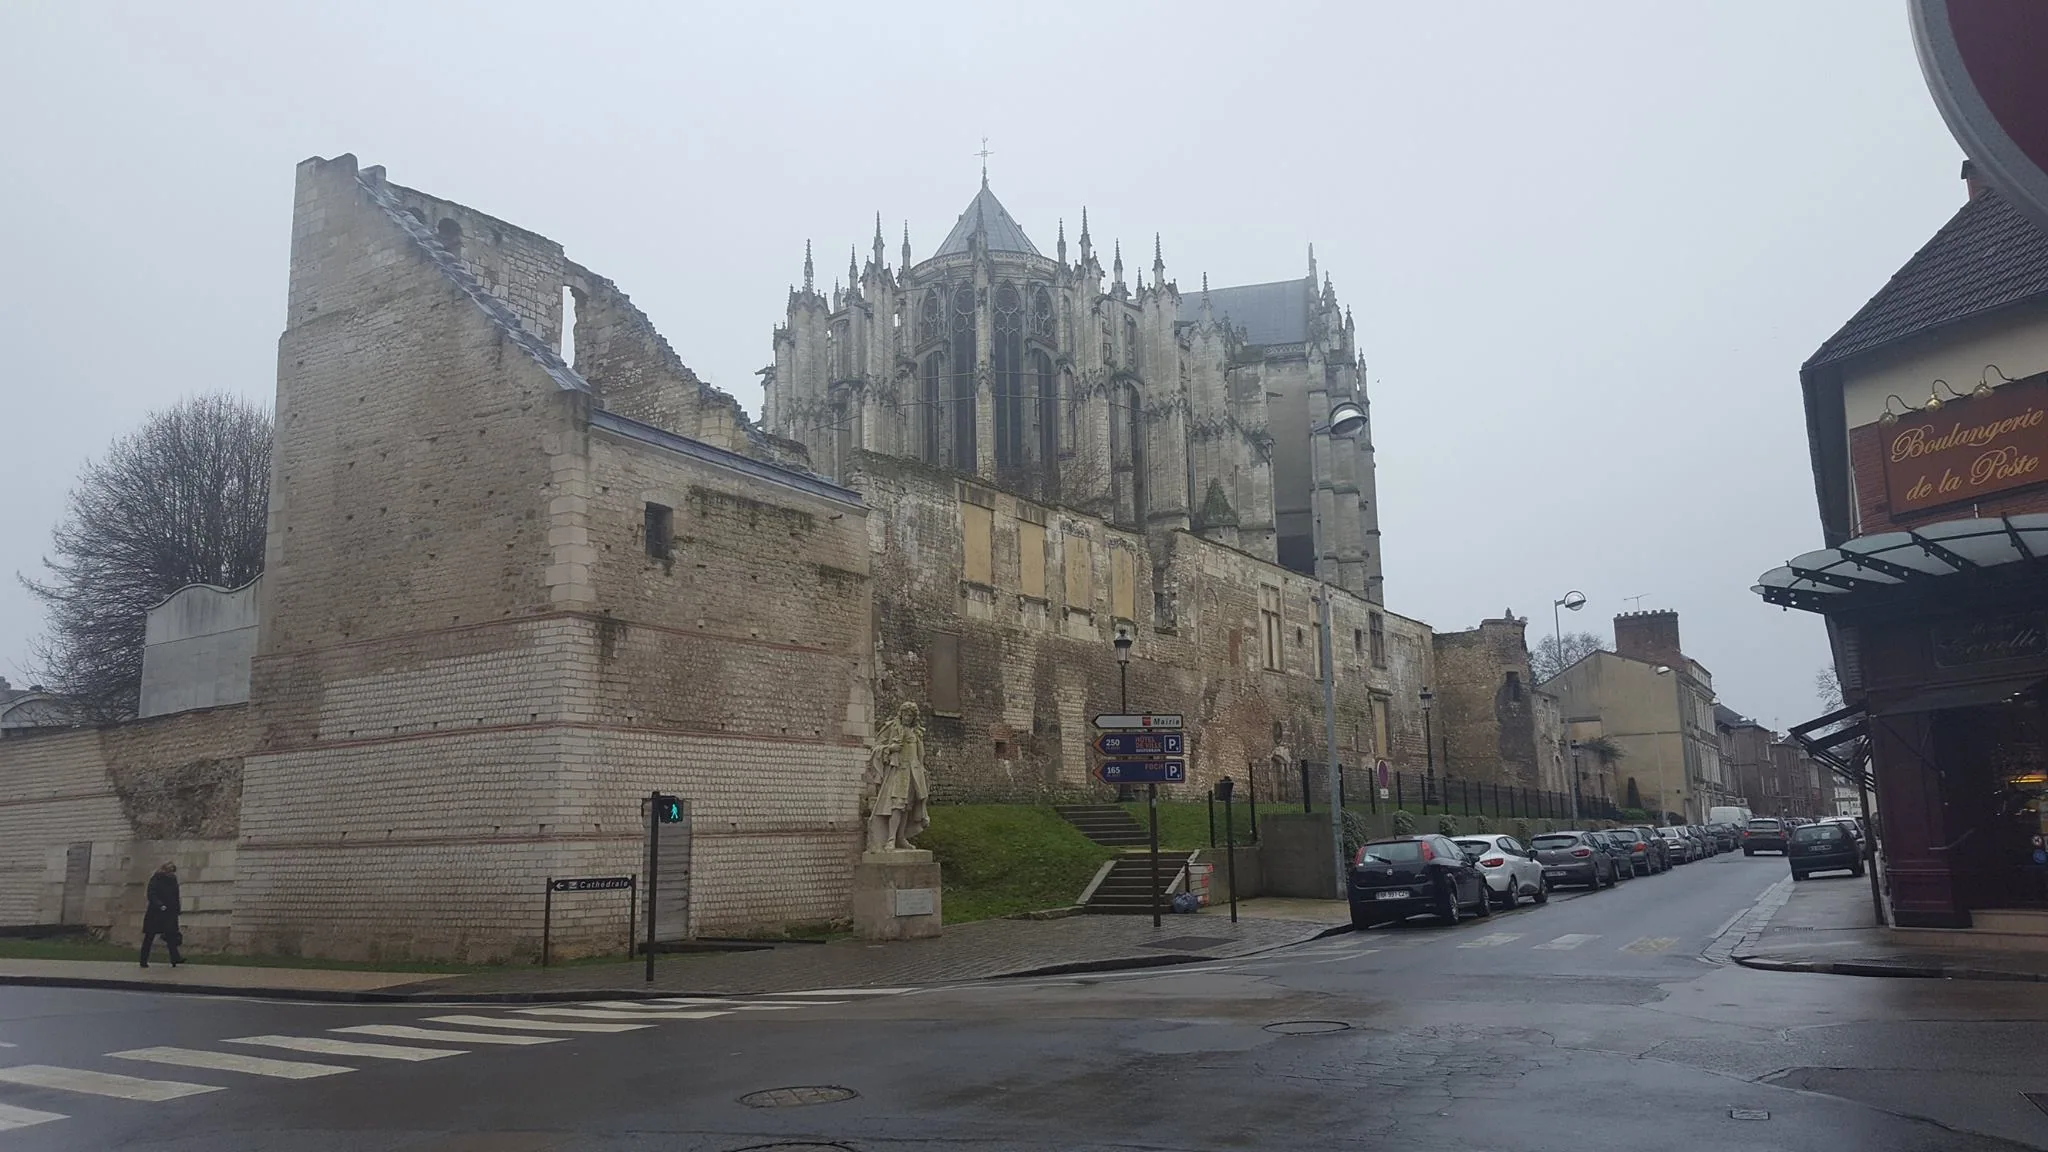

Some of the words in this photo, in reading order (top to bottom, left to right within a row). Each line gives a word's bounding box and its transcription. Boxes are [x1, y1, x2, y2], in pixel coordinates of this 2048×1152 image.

[1891, 407, 2044, 462] Boulangerie
[1906, 475, 1933, 500] de
[1938, 468, 1963, 494] la
[1970, 446, 2039, 485] Poste
[1107, 766, 1120, 774] 165
[580, 880, 628, 889] Cathédrale
